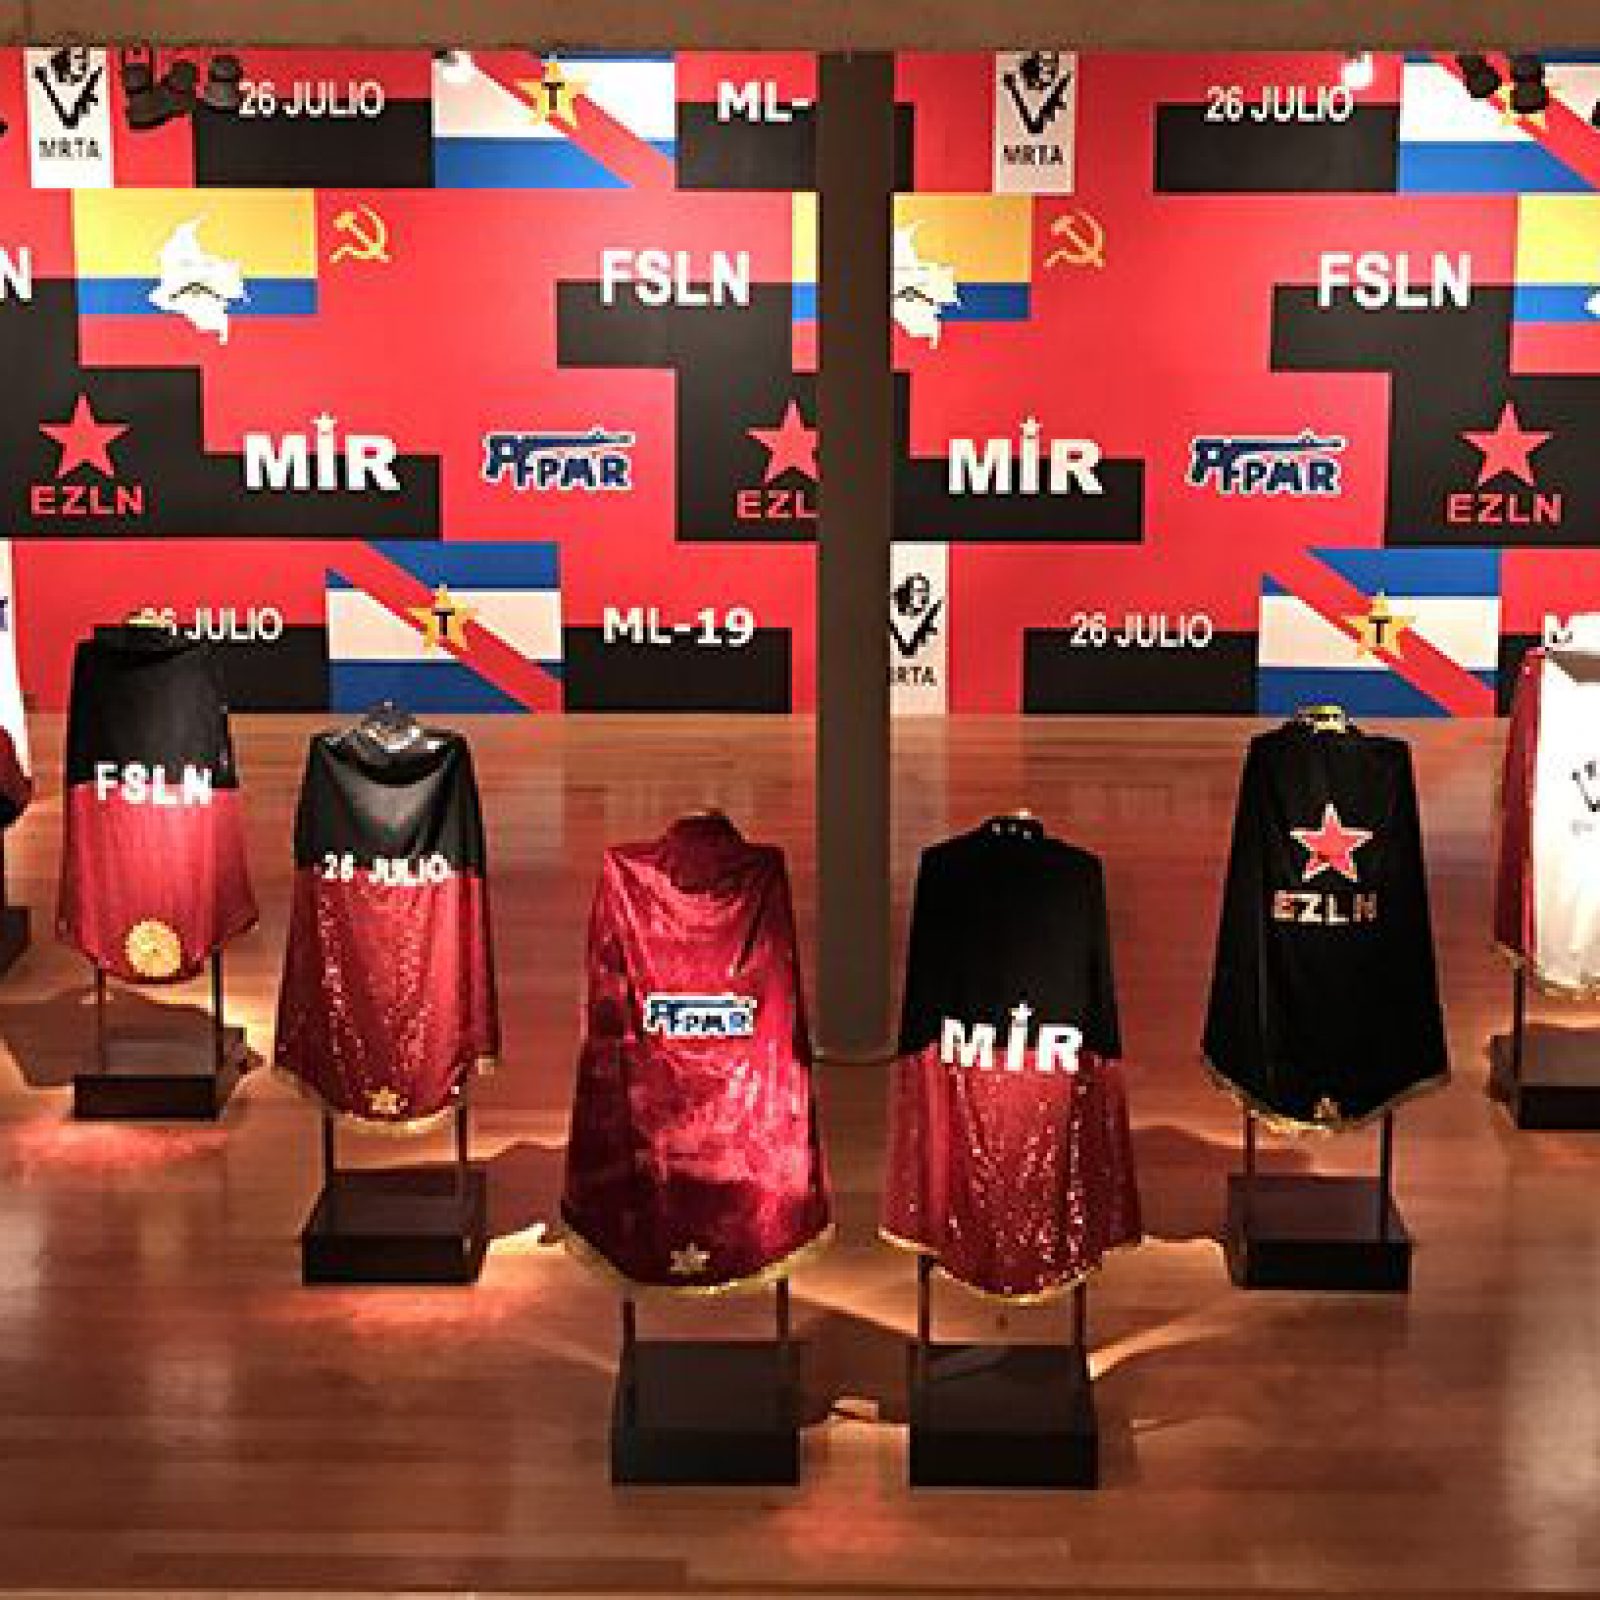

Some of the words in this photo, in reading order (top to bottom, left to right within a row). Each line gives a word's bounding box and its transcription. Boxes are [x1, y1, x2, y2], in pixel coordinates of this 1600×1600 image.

[238, 81, 275, 116] 26
[283, 81, 384, 116] JULIO
[716, 81, 813, 121] ML-
[1205, 85, 1244, 122] 26
[1251, 85, 1354, 122] JULIO
[38, 137, 102, 160] MRTA
[1003, 145, 1064, 165] MRTA
[602, 250, 750, 306] FSLN
[1318, 252, 1472, 309] FSLN
[31, 486, 144, 515] EZLN
[736, 490, 818, 518] EZL
[1446, 493, 1562, 523] EZLN
[184, 607, 283, 640] JULIO
[432, 606, 456, 636] T
[603, 607, 755, 646] ML-19
[1070, 612, 1107, 647] 26
[1115, 612, 1213, 647] JULIO
[1369, 615, 1393, 644] T
[94, 763, 213, 806] FSLN
[322, 853, 354, 882] 26
[368, 853, 450, 886] JULIO
[1270, 889, 1378, 926] EZLN
